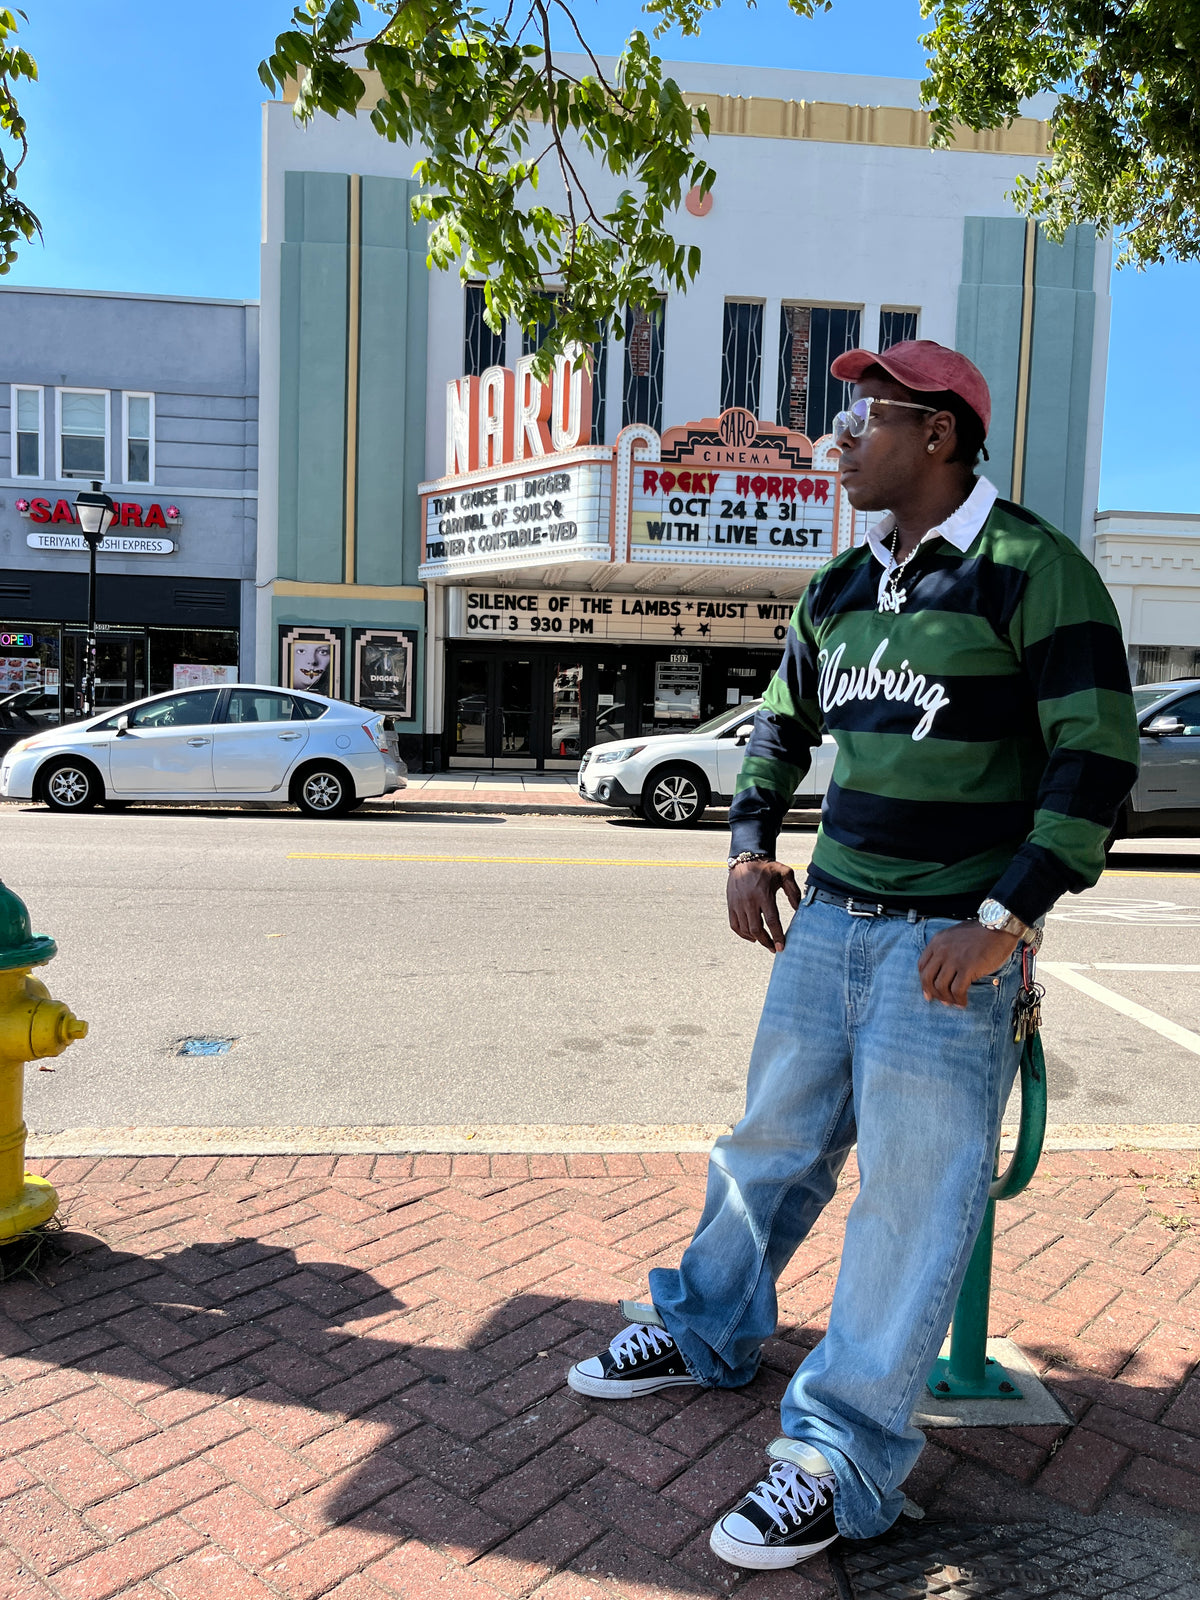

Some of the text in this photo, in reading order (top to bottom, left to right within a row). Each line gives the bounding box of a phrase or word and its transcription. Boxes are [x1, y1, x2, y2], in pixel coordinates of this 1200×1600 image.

[446, 341, 592, 476] NARO
[720, 411, 755, 448] NARO
[703, 451, 770, 465] CINEMA
[433, 473, 571, 515] TOM CRUISE IN DIGGER
[643, 469, 830, 506] ROCKY HORROR
[669, 498, 797, 521] OCT 24 & 31
[439, 513, 488, 536] CARNIVAL
[492, 508, 508, 527] OF
[38, 535, 80, 548] TERIYAKI
[97, 539, 120, 550] USHI
[122, 540, 163, 552] EXPRESS
[646, 521, 823, 548] WITH LIVE CAST
[426, 539, 466, 559] TURNER
[468, 536, 476, 554] &
[467, 593, 538, 611] SILENCE
[548, 596, 571, 612] OF
[580, 597, 613, 614] THE
[621, 599, 681, 617] LAMBS
[697, 602, 748, 619] FAUST
[467, 614, 594, 634] OCT 3 930 PM
[1, 634, 32, 646] OPEN
[370, 674, 399, 683] DIGGER
